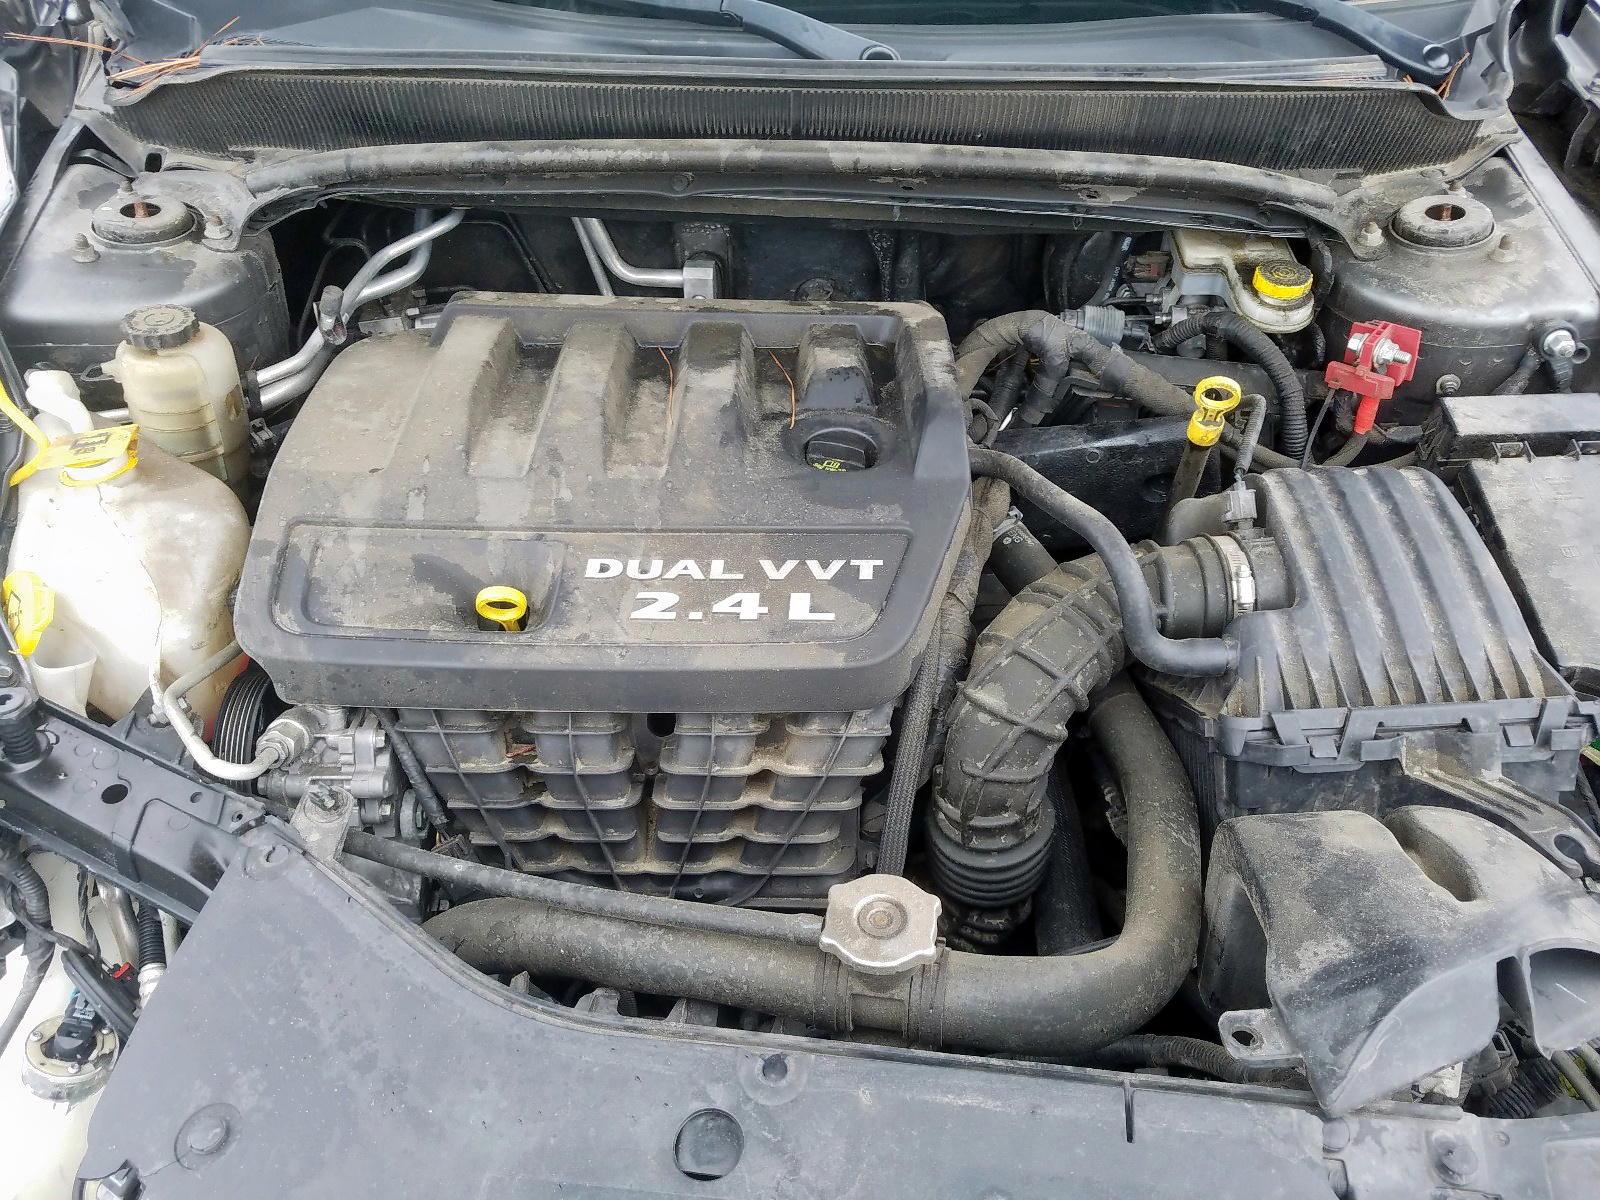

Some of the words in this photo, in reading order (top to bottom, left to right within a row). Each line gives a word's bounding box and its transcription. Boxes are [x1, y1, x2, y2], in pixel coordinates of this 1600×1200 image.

[584, 558, 745, 580] DUAL
[758, 559, 884, 580] VVT
[629, 591, 769, 620] 2.4
[787, 592, 836, 621] L
